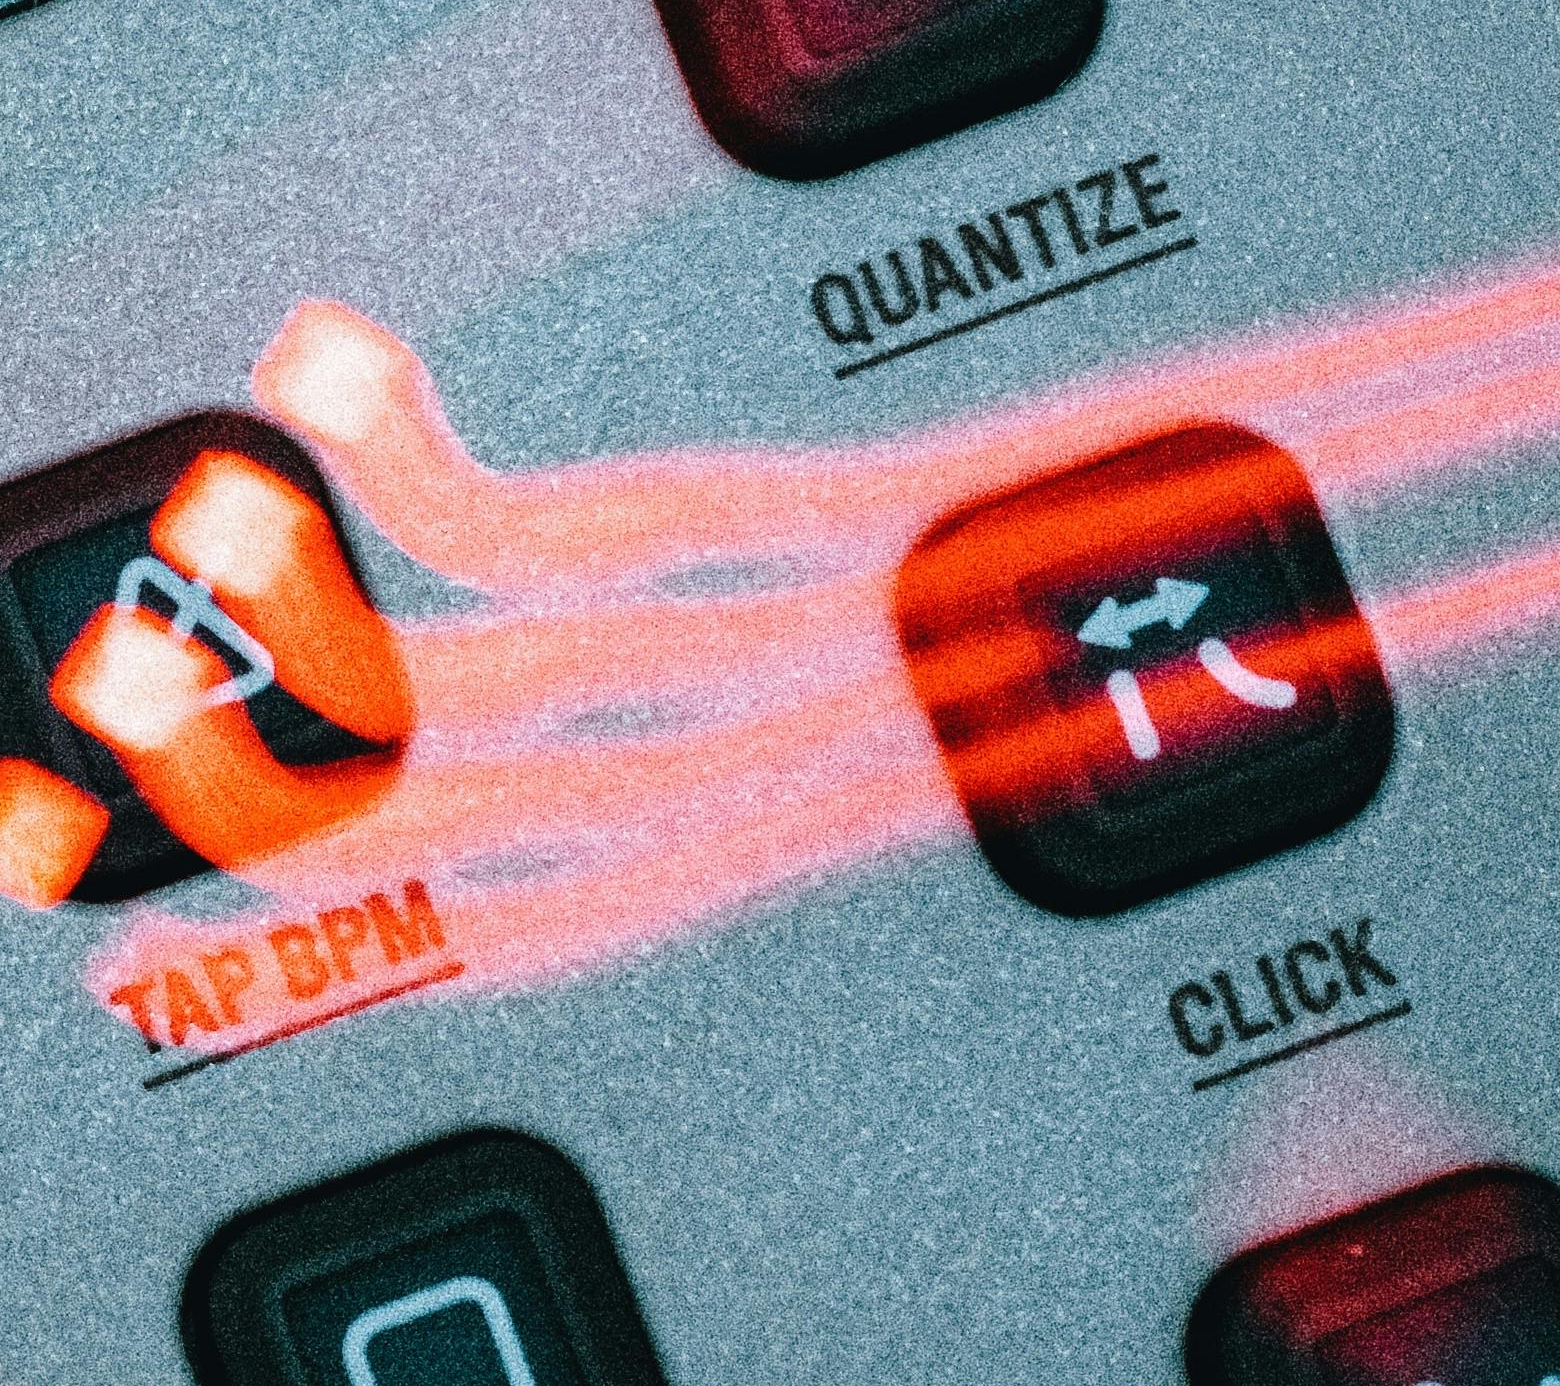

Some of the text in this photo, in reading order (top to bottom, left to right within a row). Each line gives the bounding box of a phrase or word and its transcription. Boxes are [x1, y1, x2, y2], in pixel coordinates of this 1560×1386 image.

[811, 153, 1184, 348] QUANTIZE
[110, 878, 451, 1055] TAP BPM
[1167, 918, 1397, 1059] CLICK
